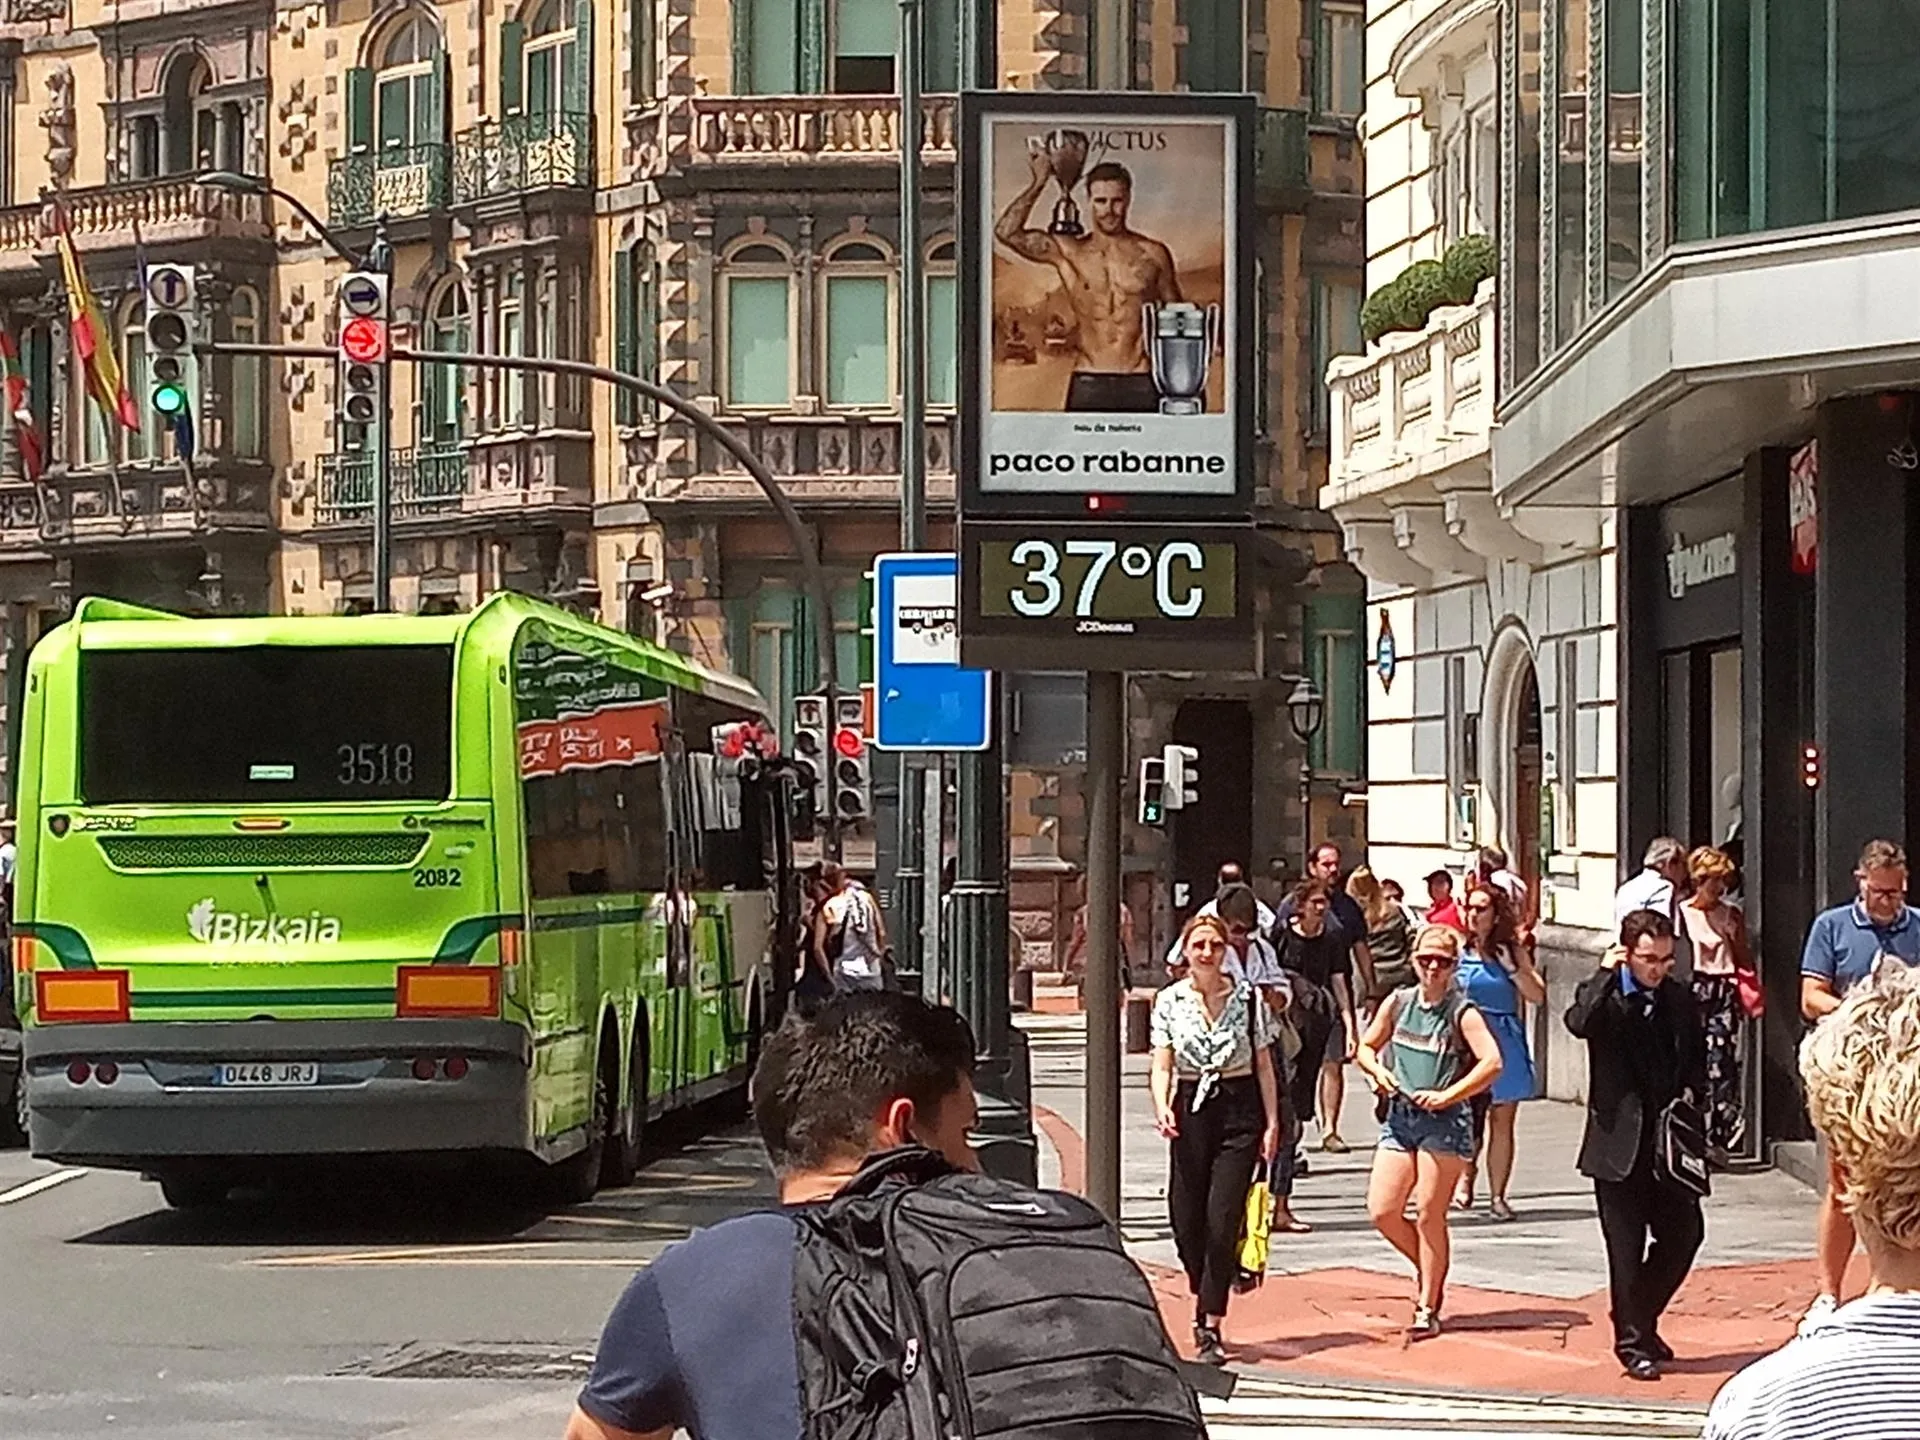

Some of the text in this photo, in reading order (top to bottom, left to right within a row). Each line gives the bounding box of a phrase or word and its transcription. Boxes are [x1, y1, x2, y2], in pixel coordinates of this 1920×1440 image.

[1053, 130, 1167, 152] VICTUS
[990, 450, 1225, 476] paco rabanne
[1010, 540, 1203, 617] 37°C
[336, 743, 413, 786] 3518
[413, 868, 462, 888] 2082
[211, 910, 341, 945] Bizkaia
[225, 1064, 314, 1082] 0448 JRJ
